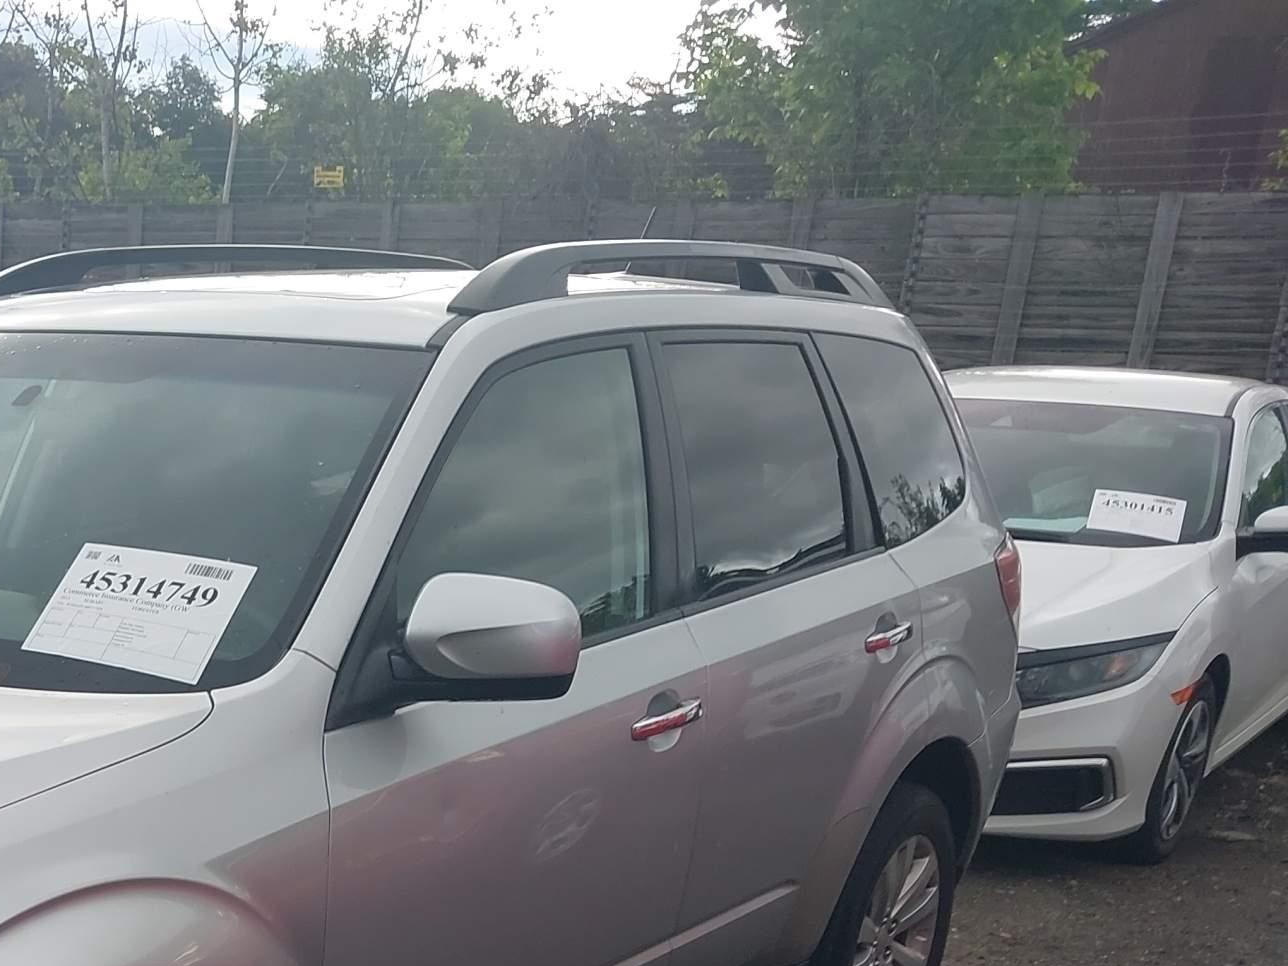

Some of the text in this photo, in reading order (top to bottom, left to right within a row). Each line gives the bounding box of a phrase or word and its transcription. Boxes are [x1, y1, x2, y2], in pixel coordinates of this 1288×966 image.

[80, 569, 219, 608] 45314749
[101, 592, 135, 603] Insurance
[136, 597, 169, 611] Company
